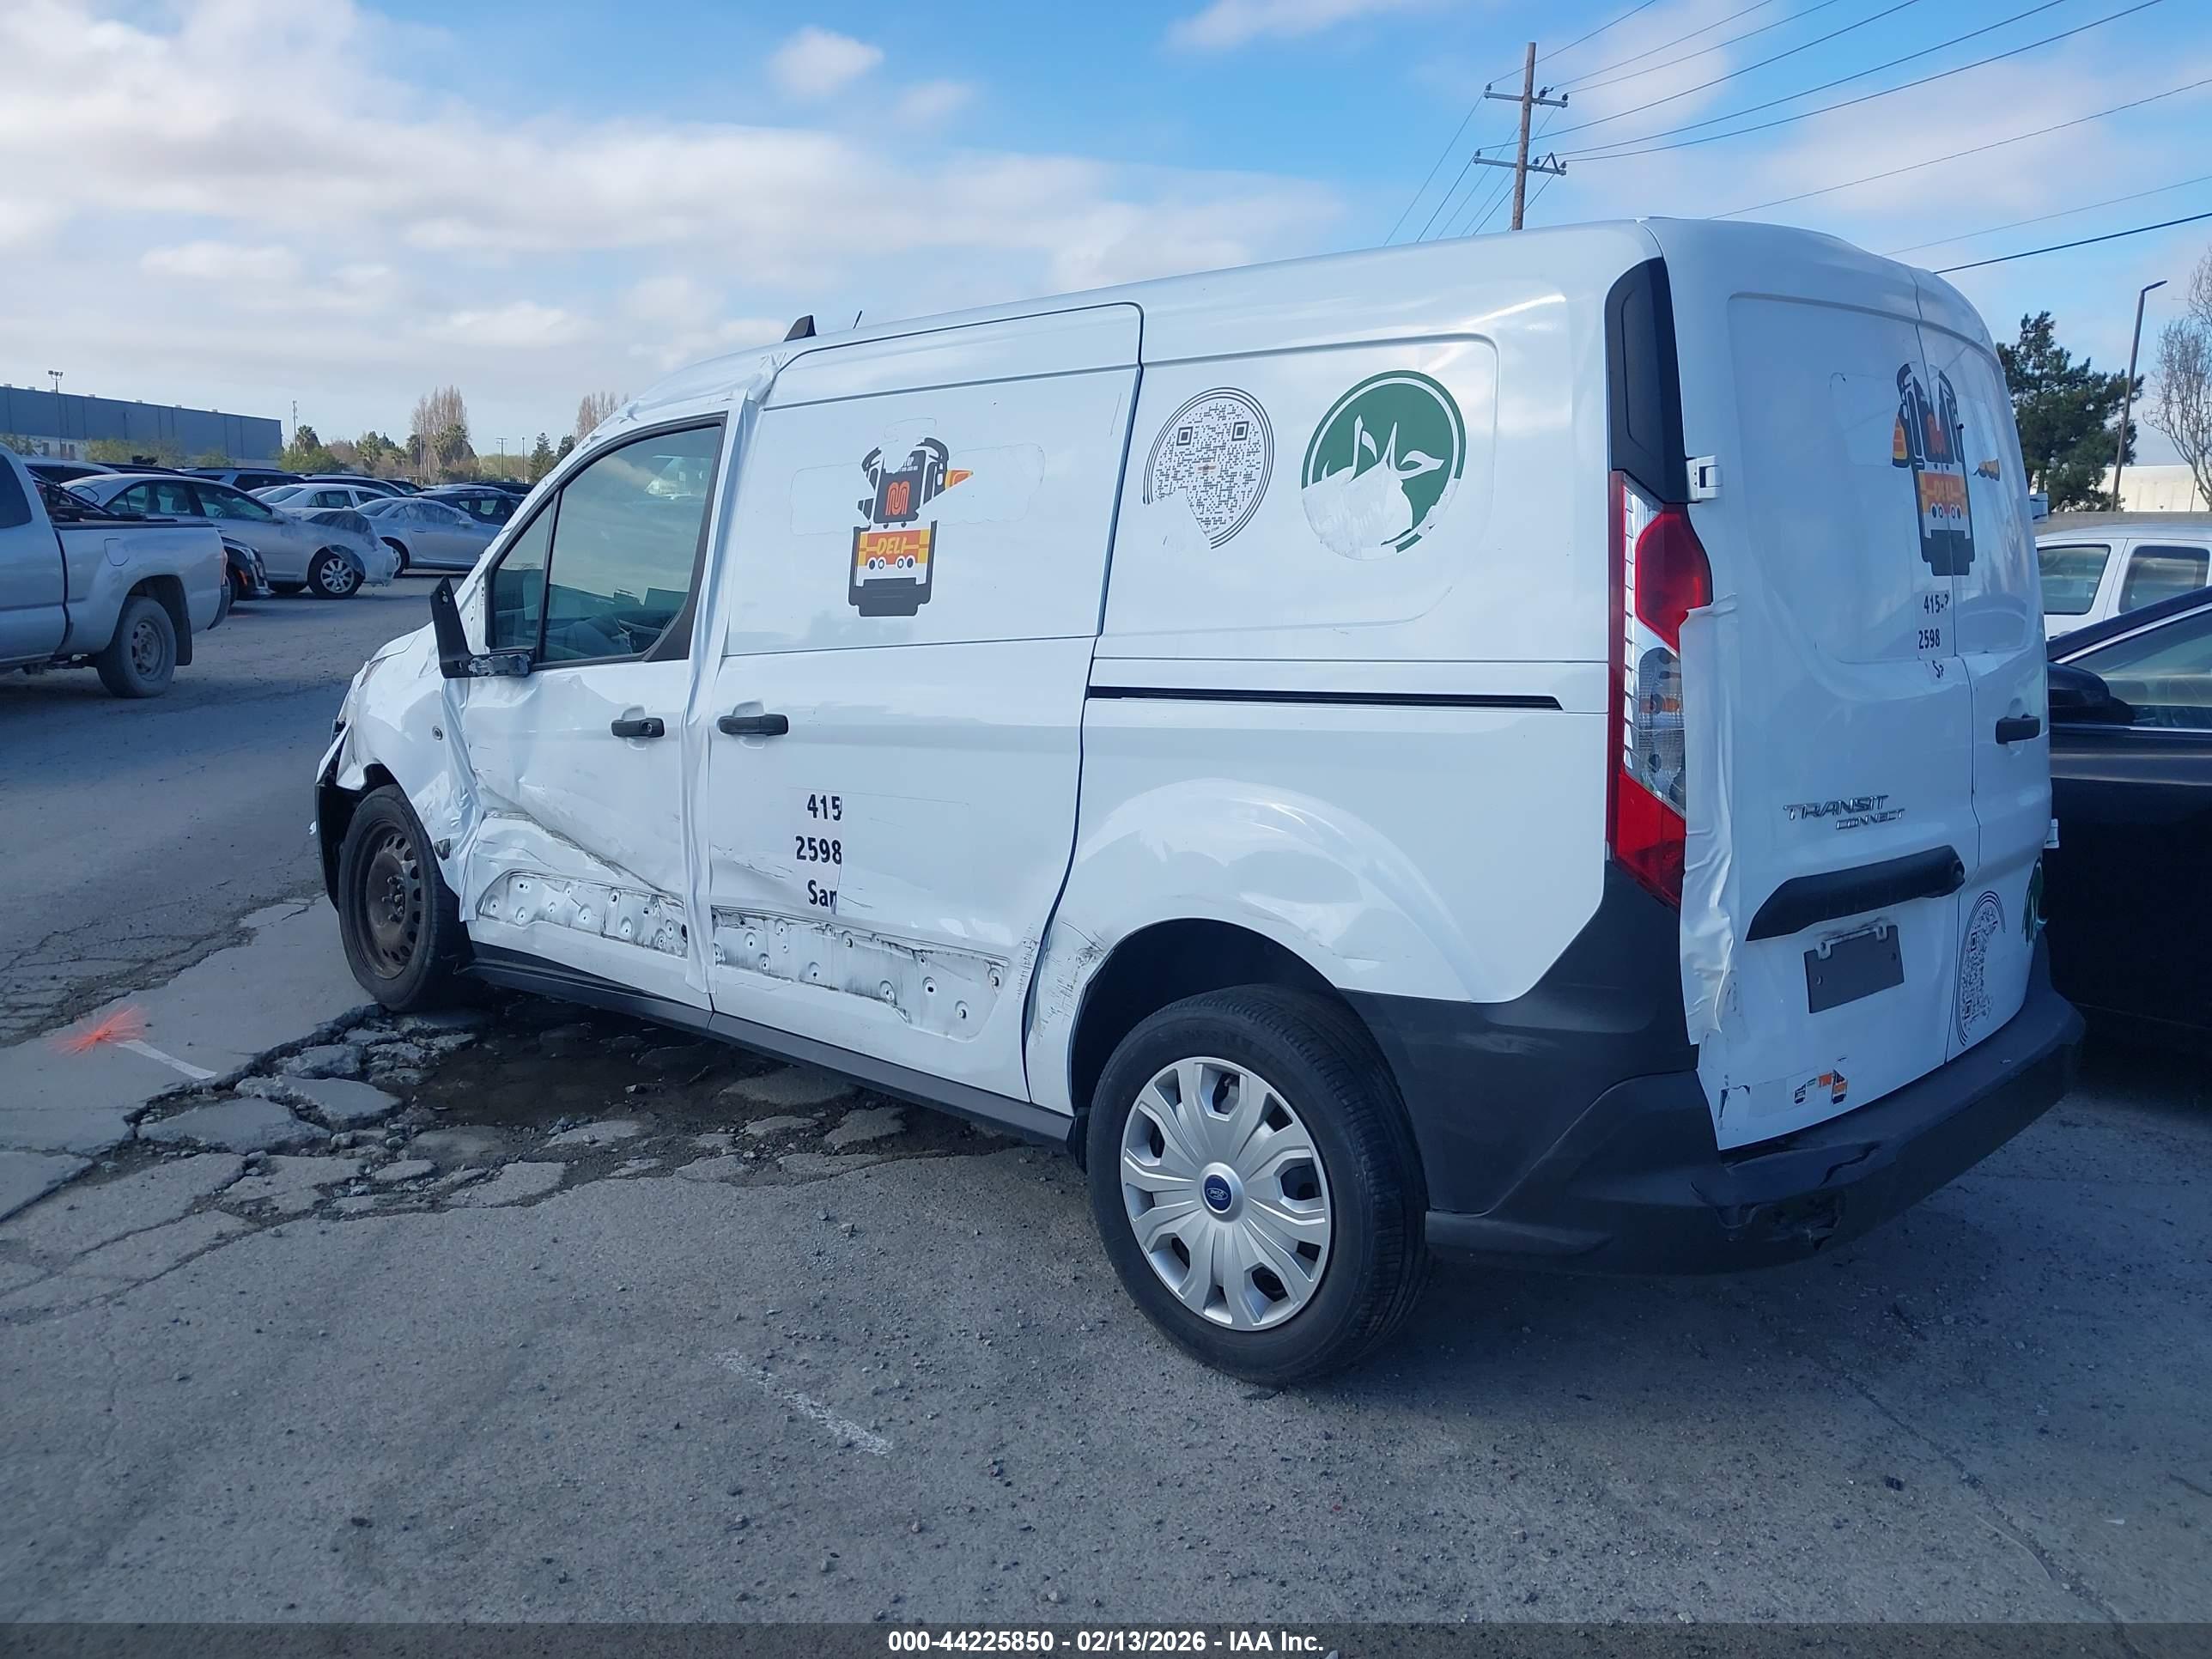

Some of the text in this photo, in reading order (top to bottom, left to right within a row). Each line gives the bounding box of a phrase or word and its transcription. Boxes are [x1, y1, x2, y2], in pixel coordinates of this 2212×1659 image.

[876, 536, 908, 555] DELI
[1918, 628, 1941, 649] 2598
[807, 793, 842, 821] 415
[1784, 794, 1889, 820] TRANSIT
[1835, 807, 1905, 830] CONNECT
[795, 836, 842, 866] 2598
